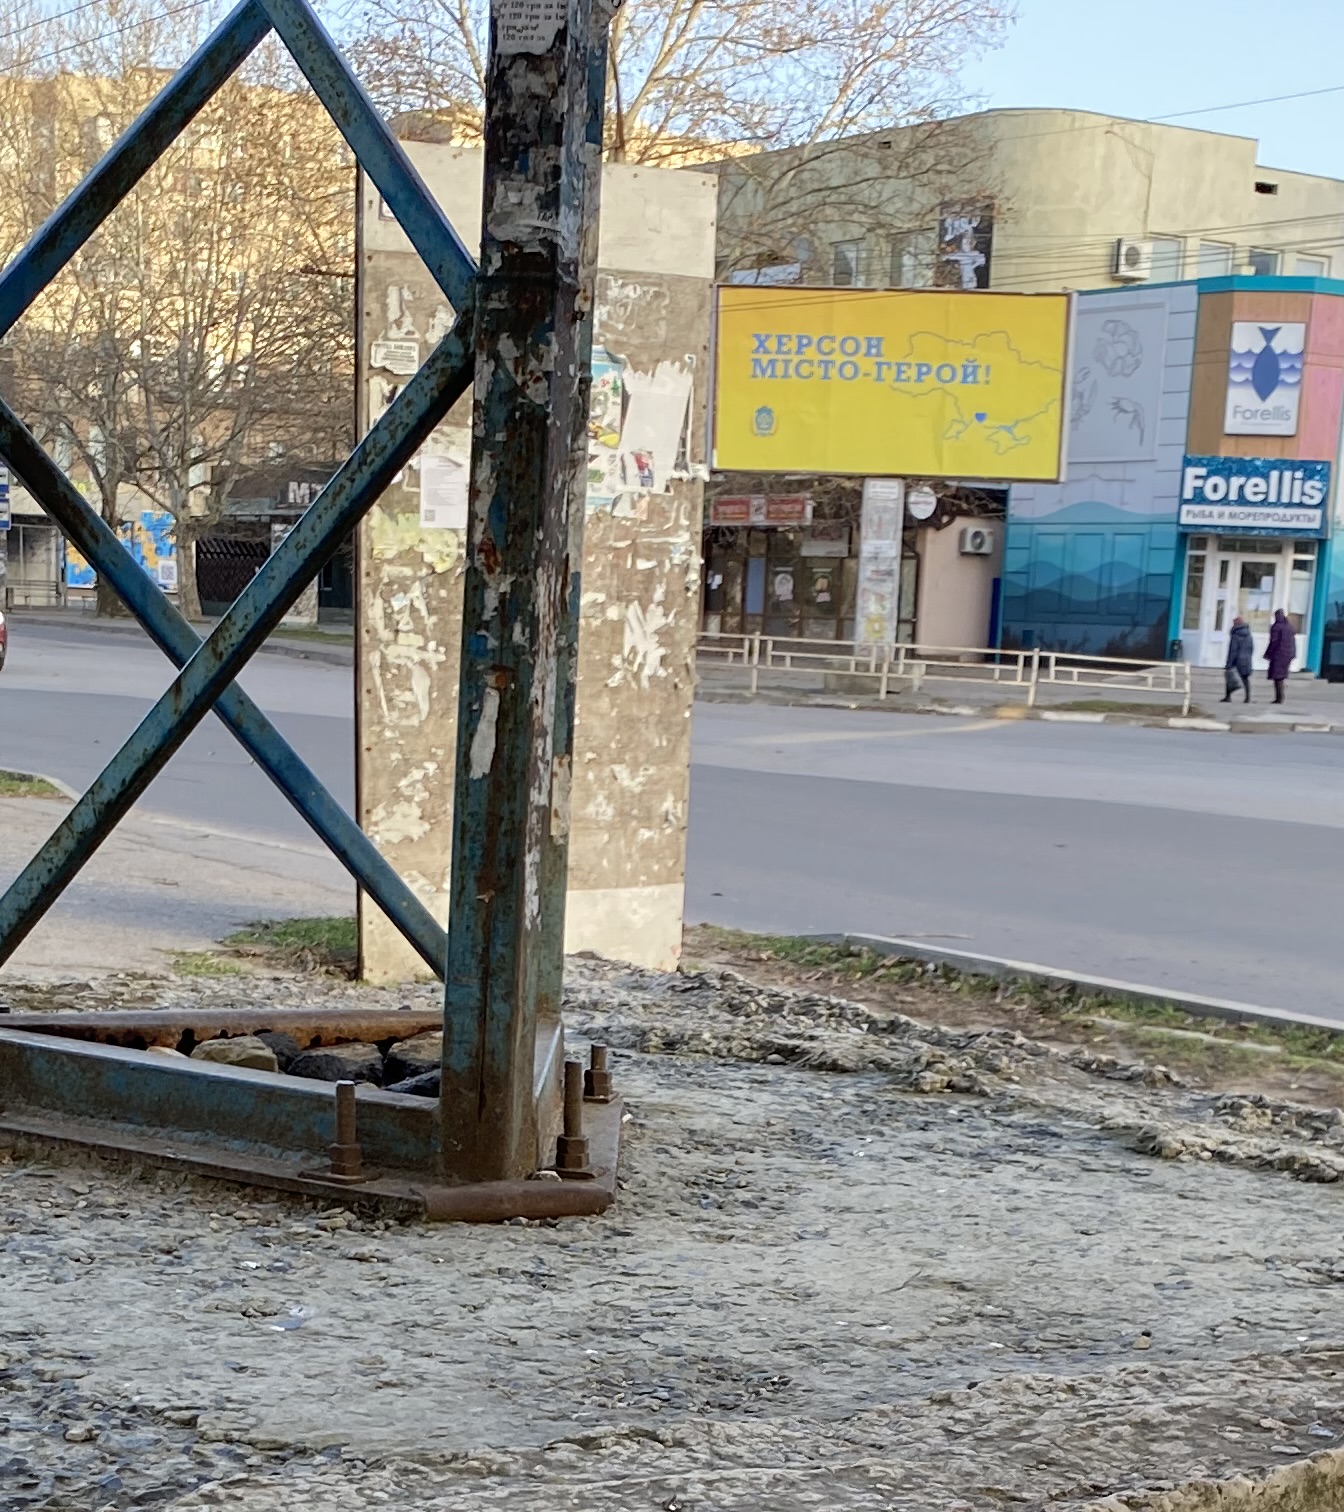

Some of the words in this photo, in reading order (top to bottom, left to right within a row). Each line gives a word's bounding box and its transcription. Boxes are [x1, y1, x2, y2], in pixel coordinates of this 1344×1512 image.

[751, 333, 885, 358] ХЕРСОН
[750, 357, 992, 385] МІСТО-ГЕРОЙ!
[1232, 405, 1292, 422] Forellis
[1182, 466, 1324, 506] Forellis
[1186, 509, 1214, 519] РЫБА
[1228, 511, 1317, 523] МОРЕПРОДУКТЫ
